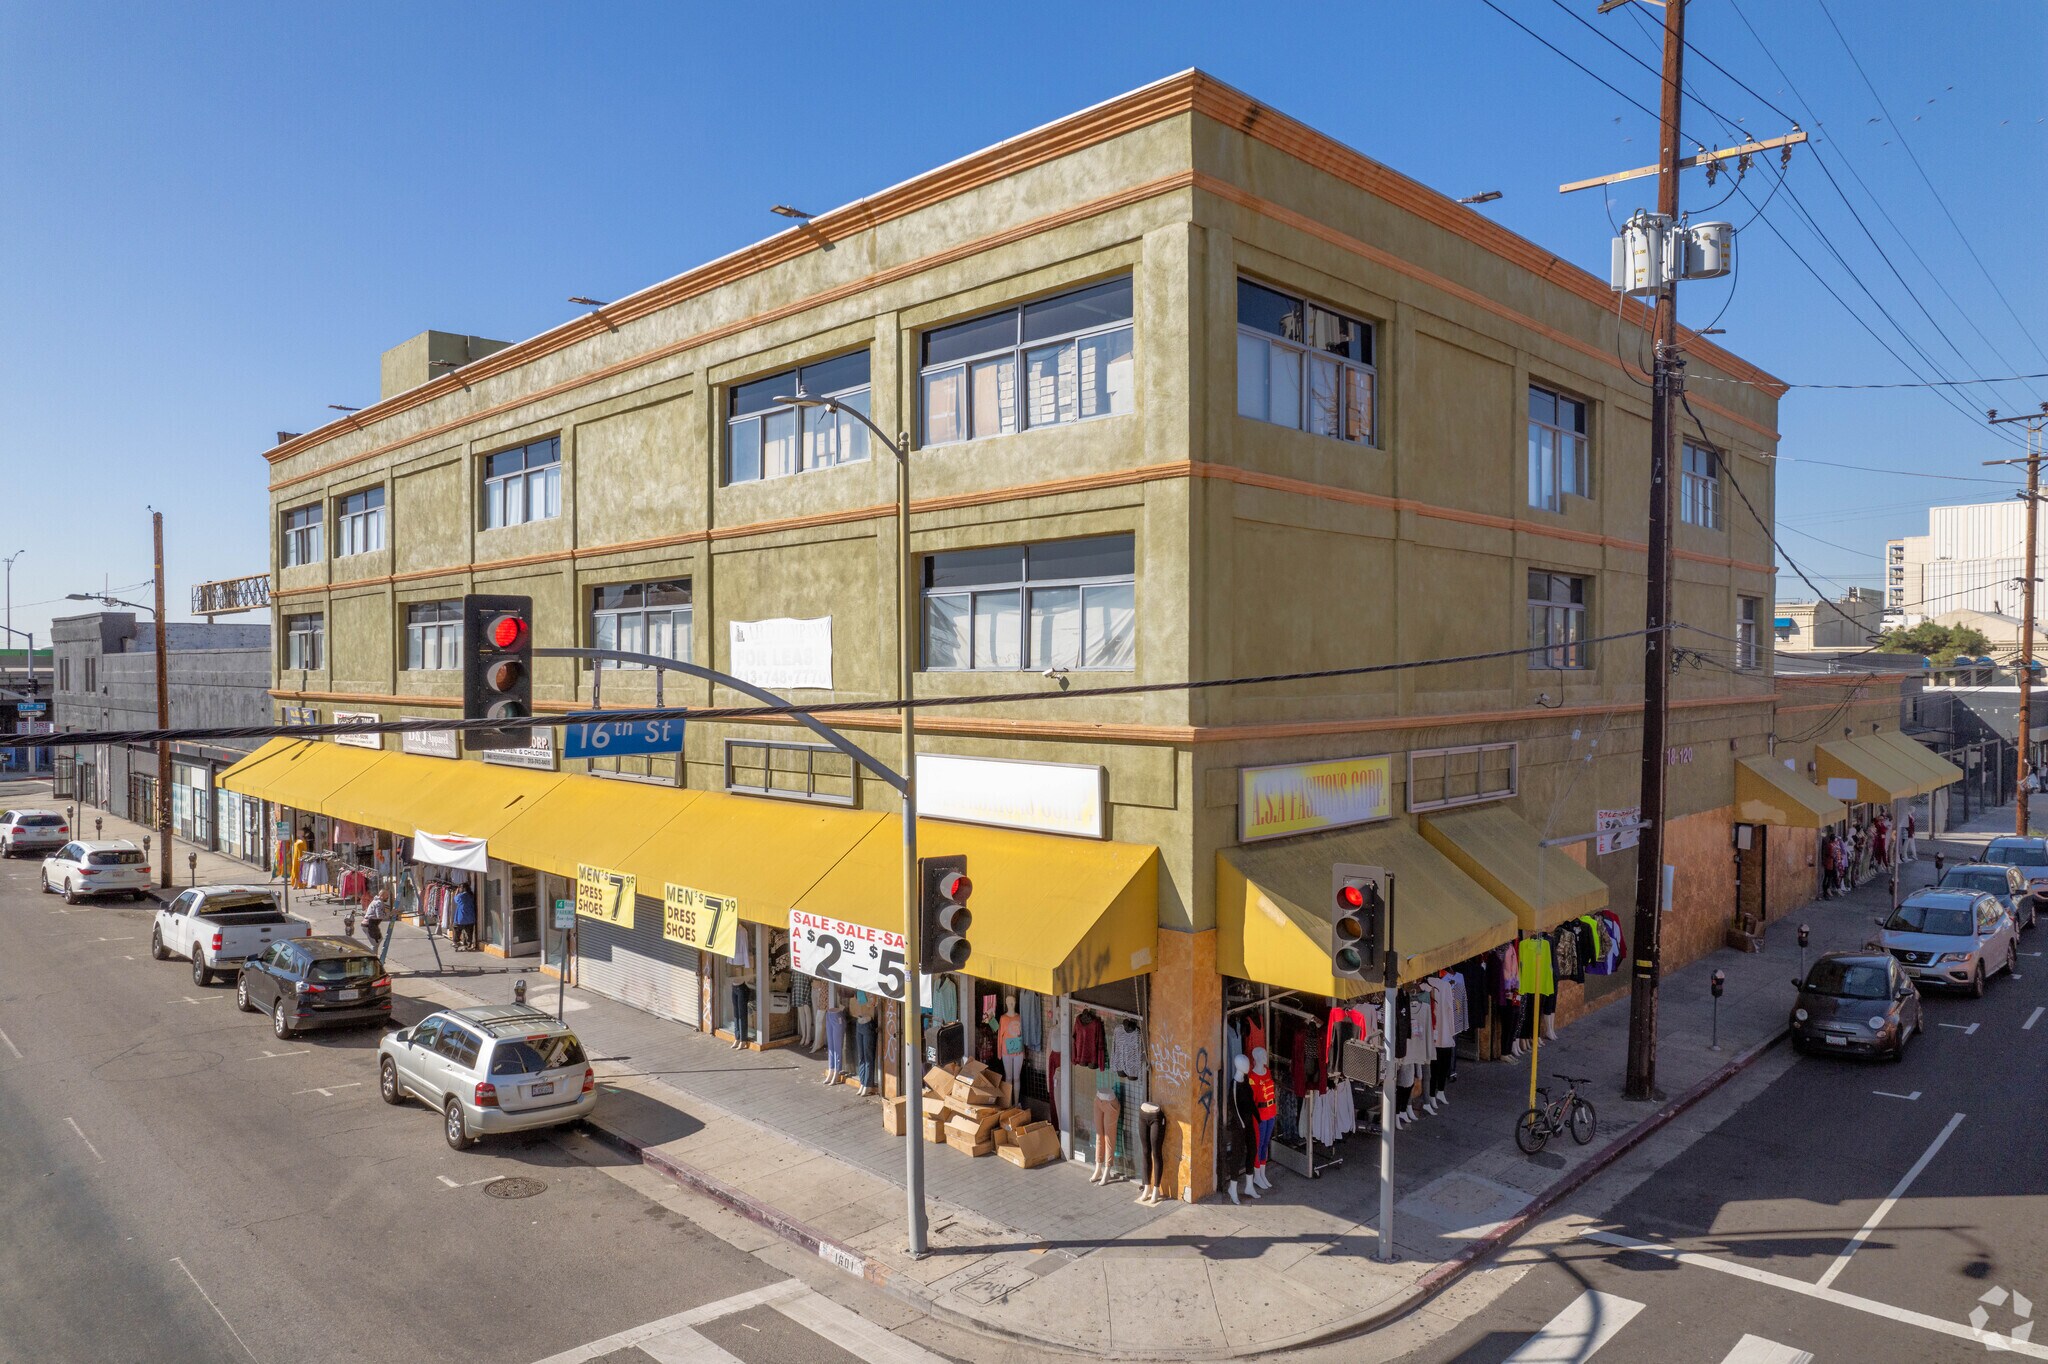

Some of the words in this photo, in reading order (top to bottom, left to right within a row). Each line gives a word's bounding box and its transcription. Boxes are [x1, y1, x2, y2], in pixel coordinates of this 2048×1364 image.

[427, 732, 449, 747] Apparel
[530, 736, 549, 750] ORP.
[580, 721, 633, 749] 16th
[644, 720, 672, 743] St
[524, 749, 551, 758] CHILDREN
[1251, 782, 1286, 826] A.S.A
[1290, 772, 1347, 821] FASHIONS
[579, 865, 609, 883] MEN'S
[579, 884, 603, 901] DRESS
[666, 885, 703, 906] MEN'S
[578, 899, 603, 916] SHOES
[667, 906, 696, 925] DRESS
[666, 922, 696, 942] SHOES
